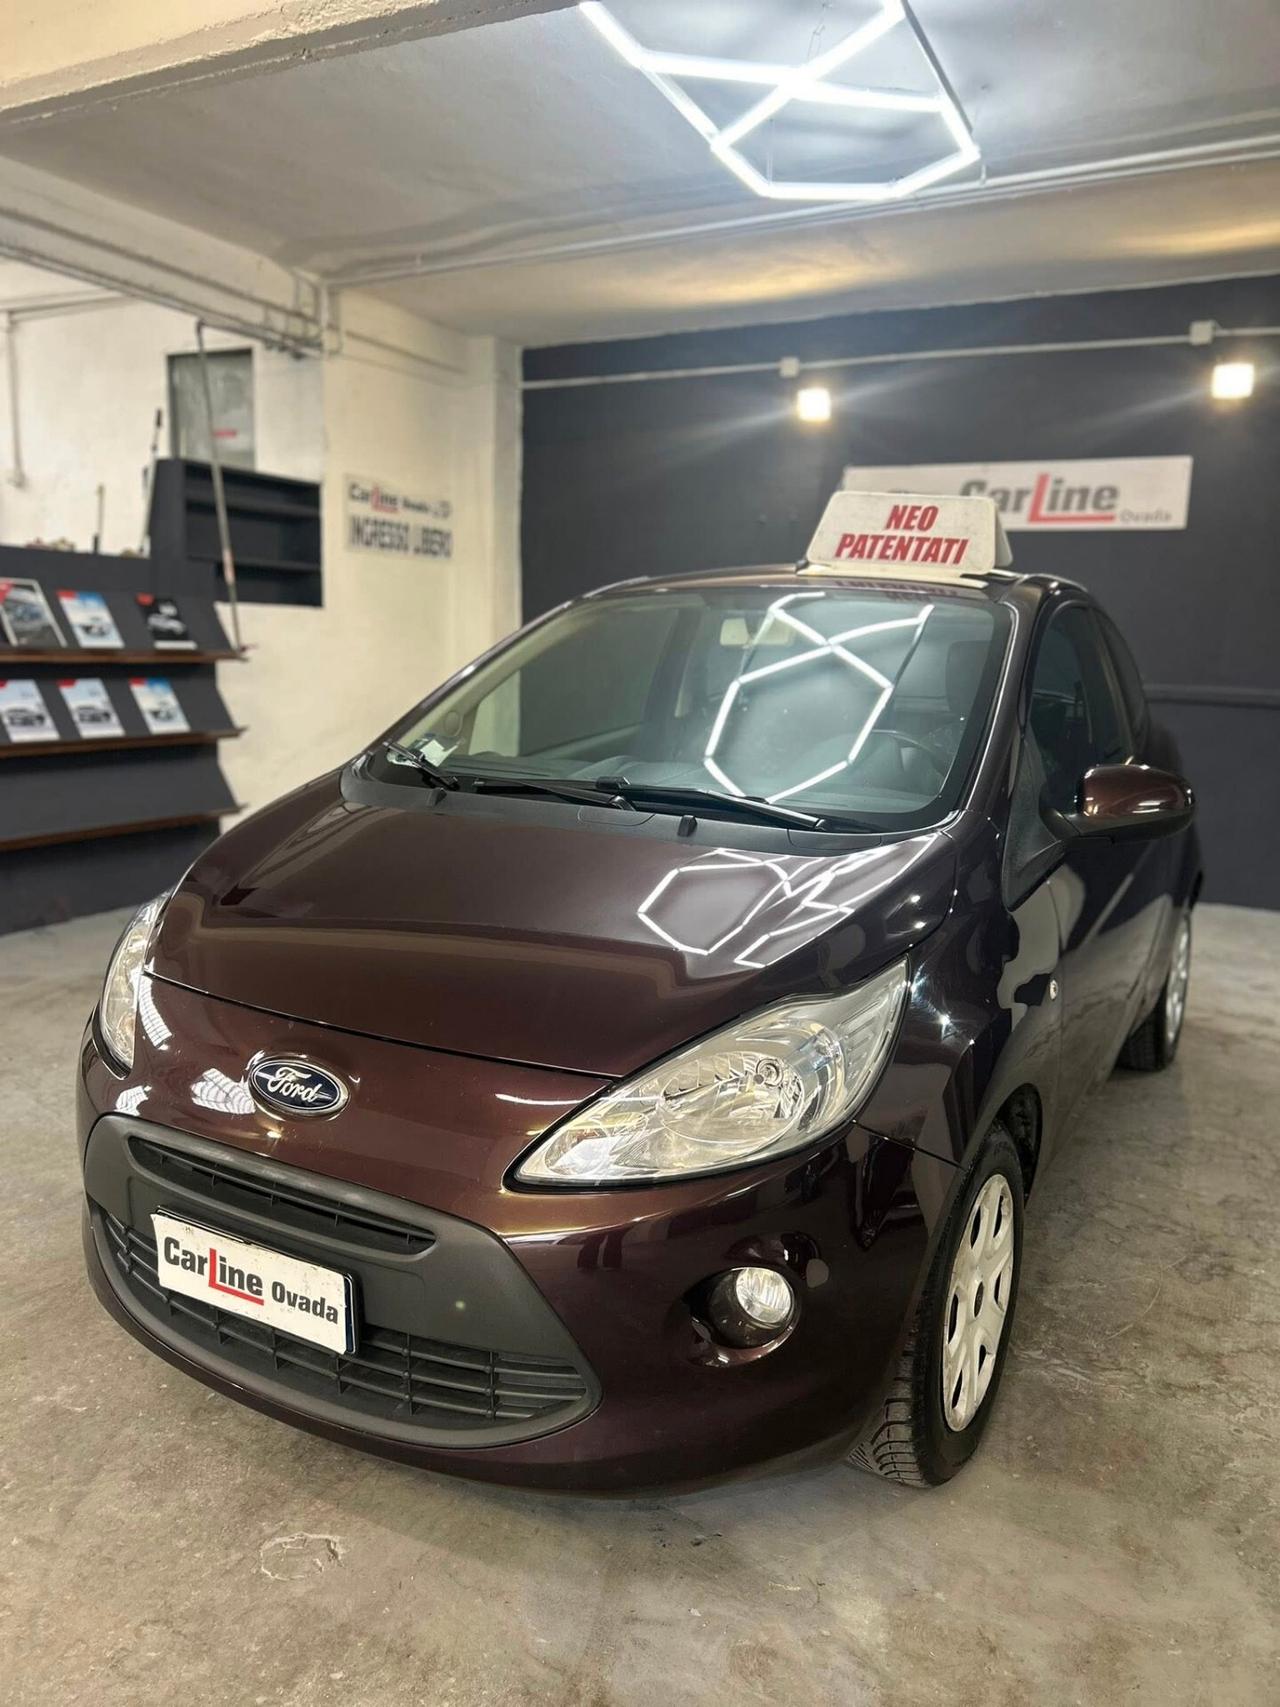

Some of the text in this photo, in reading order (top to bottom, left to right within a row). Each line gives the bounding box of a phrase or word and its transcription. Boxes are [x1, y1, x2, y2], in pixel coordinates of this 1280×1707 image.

[885, 505, 939, 532] NEO
[834, 533, 969, 565] PATENTATI
[267, 1066, 322, 1103] Ford
[163, 1236, 339, 1325] CarLine Ovada
